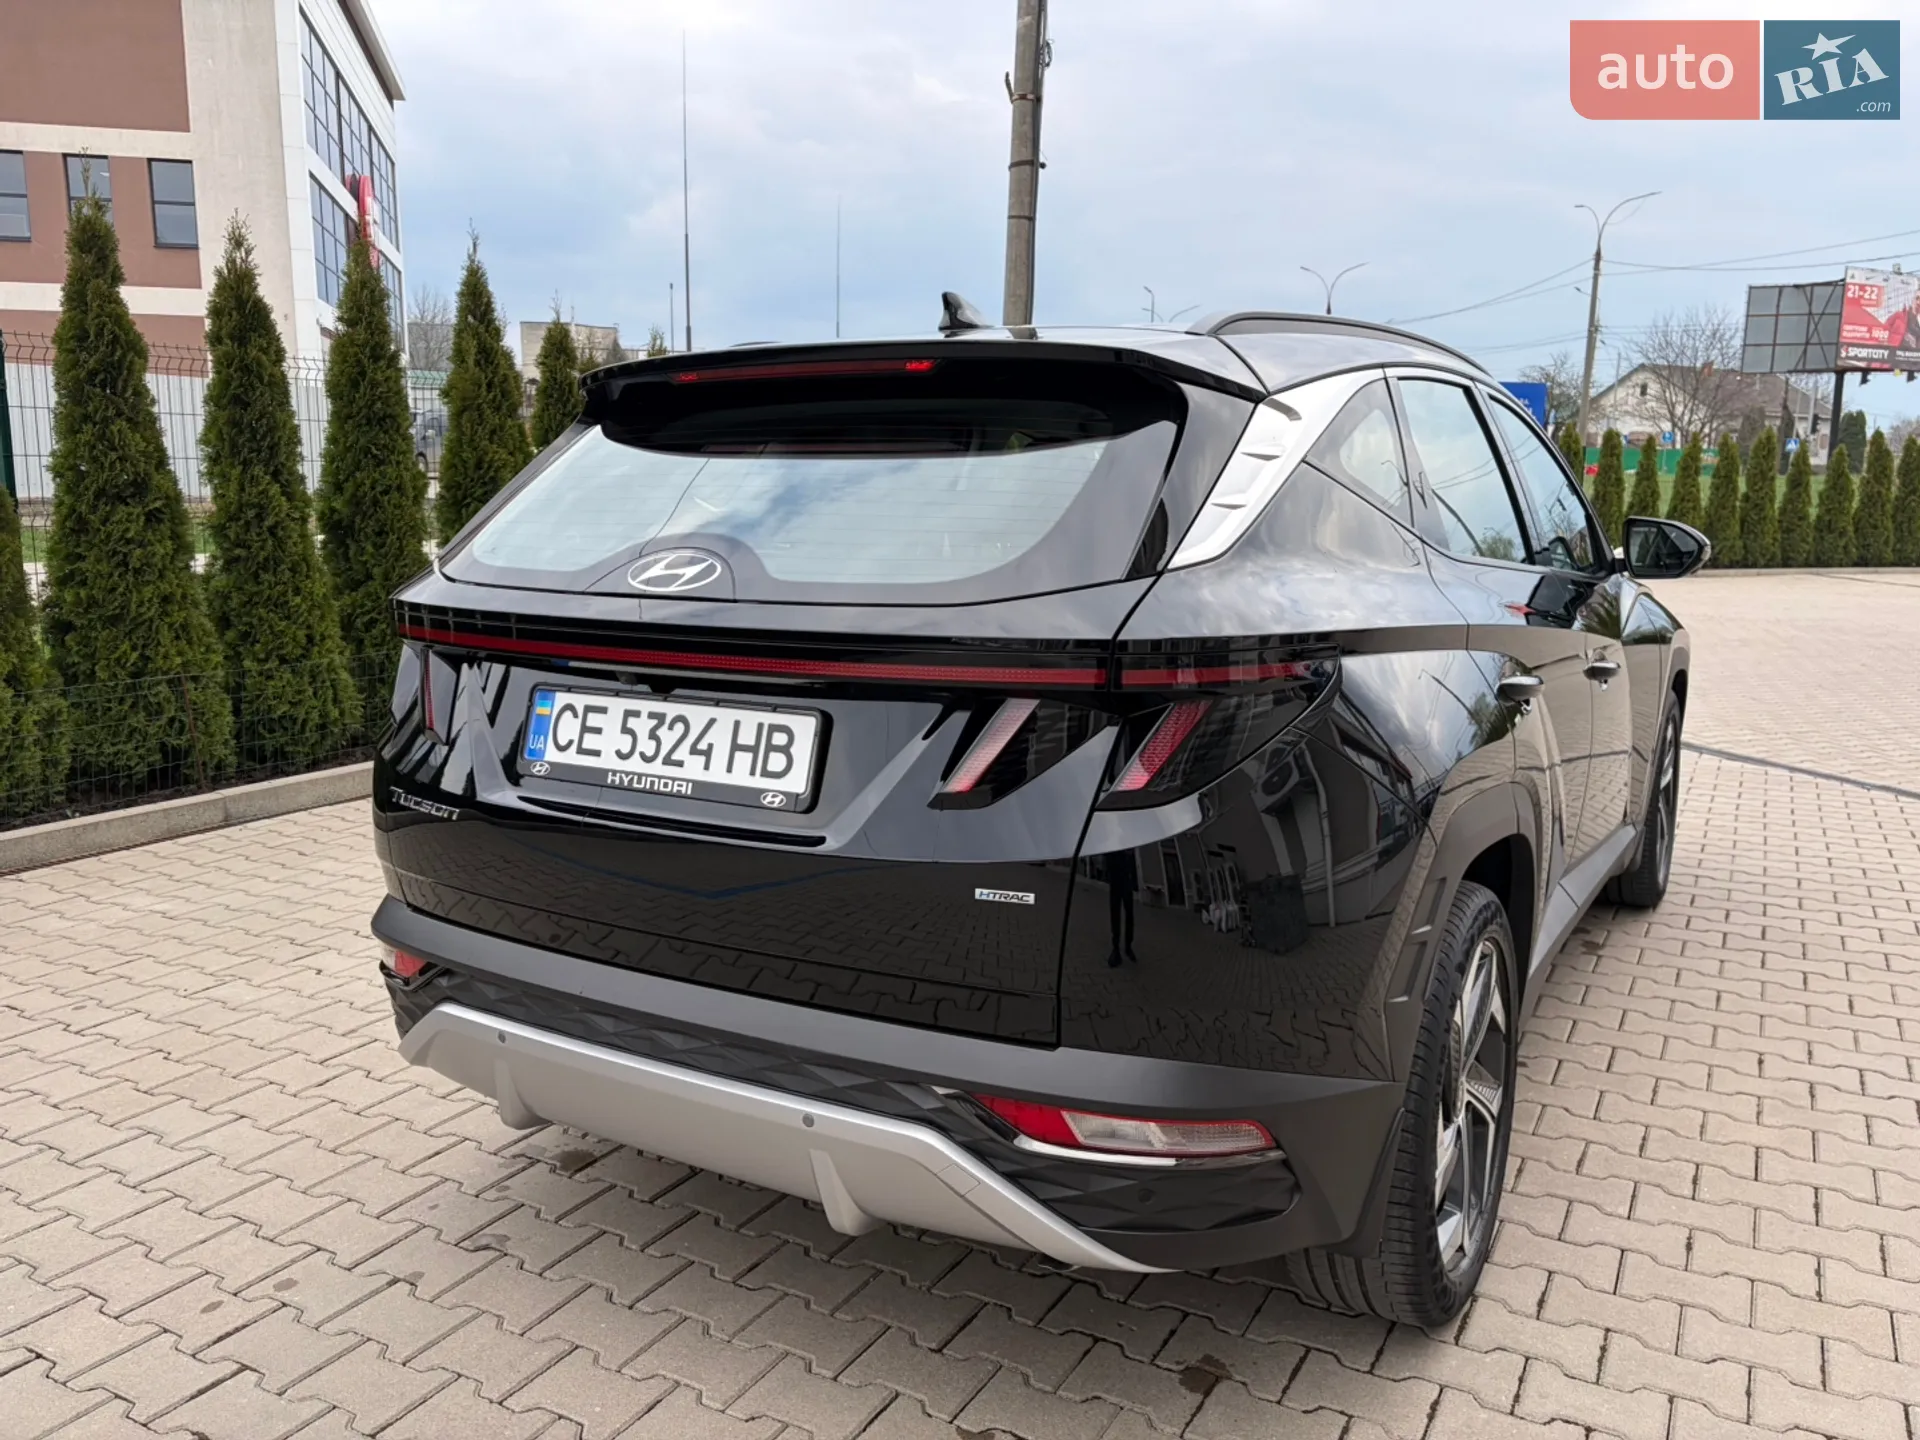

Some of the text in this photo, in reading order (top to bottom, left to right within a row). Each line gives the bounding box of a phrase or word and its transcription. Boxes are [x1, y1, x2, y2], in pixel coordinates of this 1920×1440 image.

[1846, 284, 1879, 300] 21-22
[529, 733, 545, 750] UA
[552, 702, 796, 780] CE 5324 HB
[607, 771, 693, 796] HYUNDAI
[389, 785, 460, 821] TUCSON
[978, 890, 1031, 903] HTRAC
